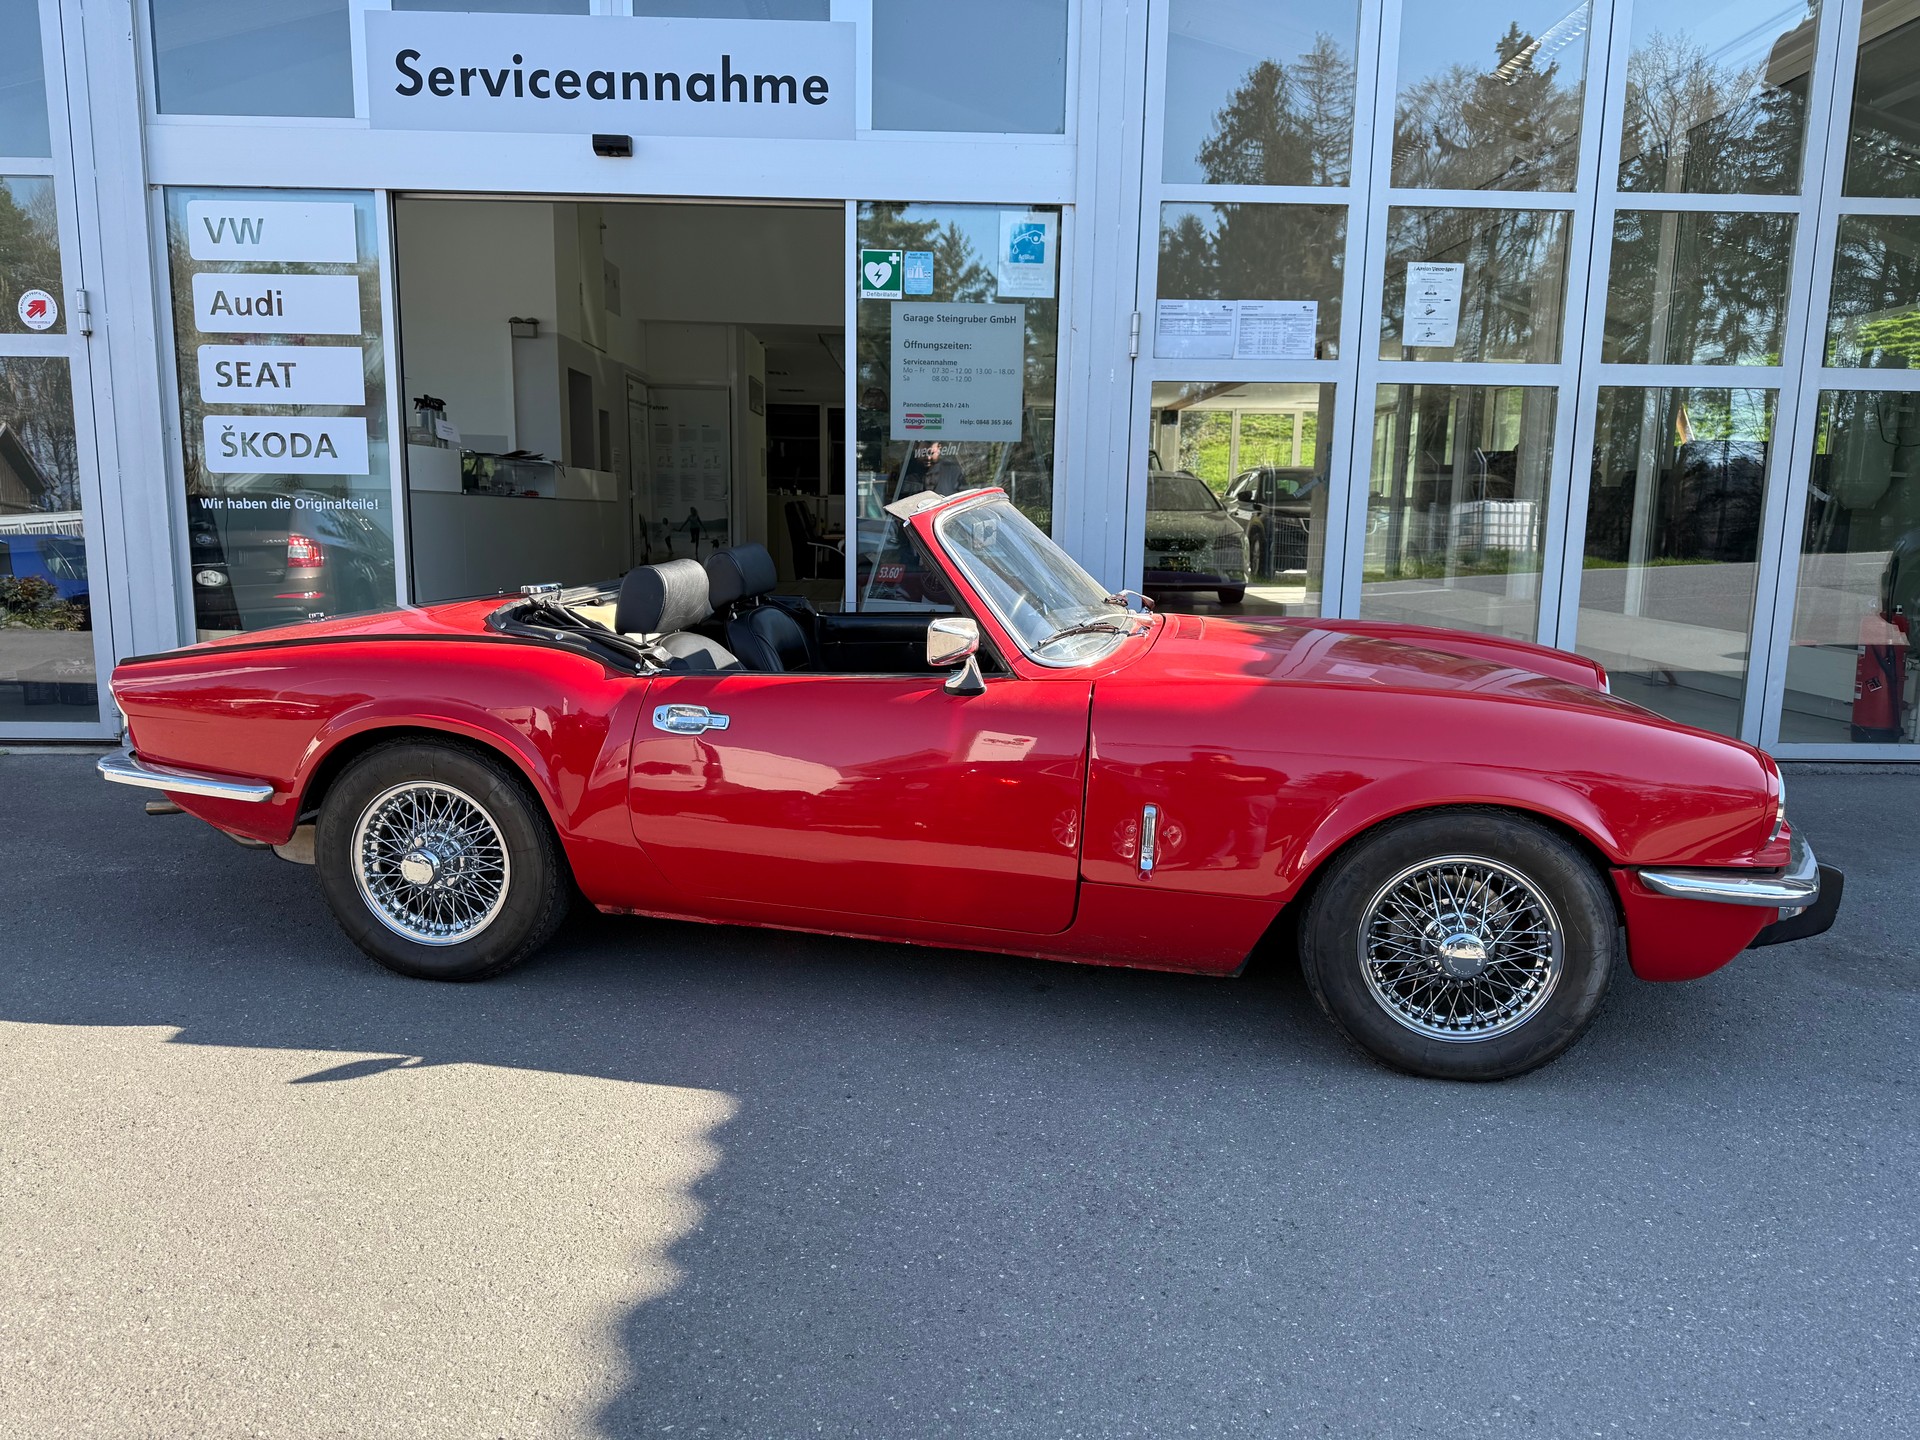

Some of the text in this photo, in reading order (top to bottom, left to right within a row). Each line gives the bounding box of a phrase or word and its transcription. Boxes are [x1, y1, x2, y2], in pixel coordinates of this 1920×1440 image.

[395, 48, 829, 105] Serviceannahme
[203, 217, 264, 245] VW
[210, 290, 284, 316] Audi
[903, 313, 1017, 324] Garage Steingruber GmbH
[903, 338, 972, 351] Öffnungszeiten:
[215, 361, 297, 388] SEAT
[903, 358, 958, 366] Serviceannahme
[220, 425, 338, 458] ŠKODA
[200, 498, 379, 512] Wir haben die Originalteile!
